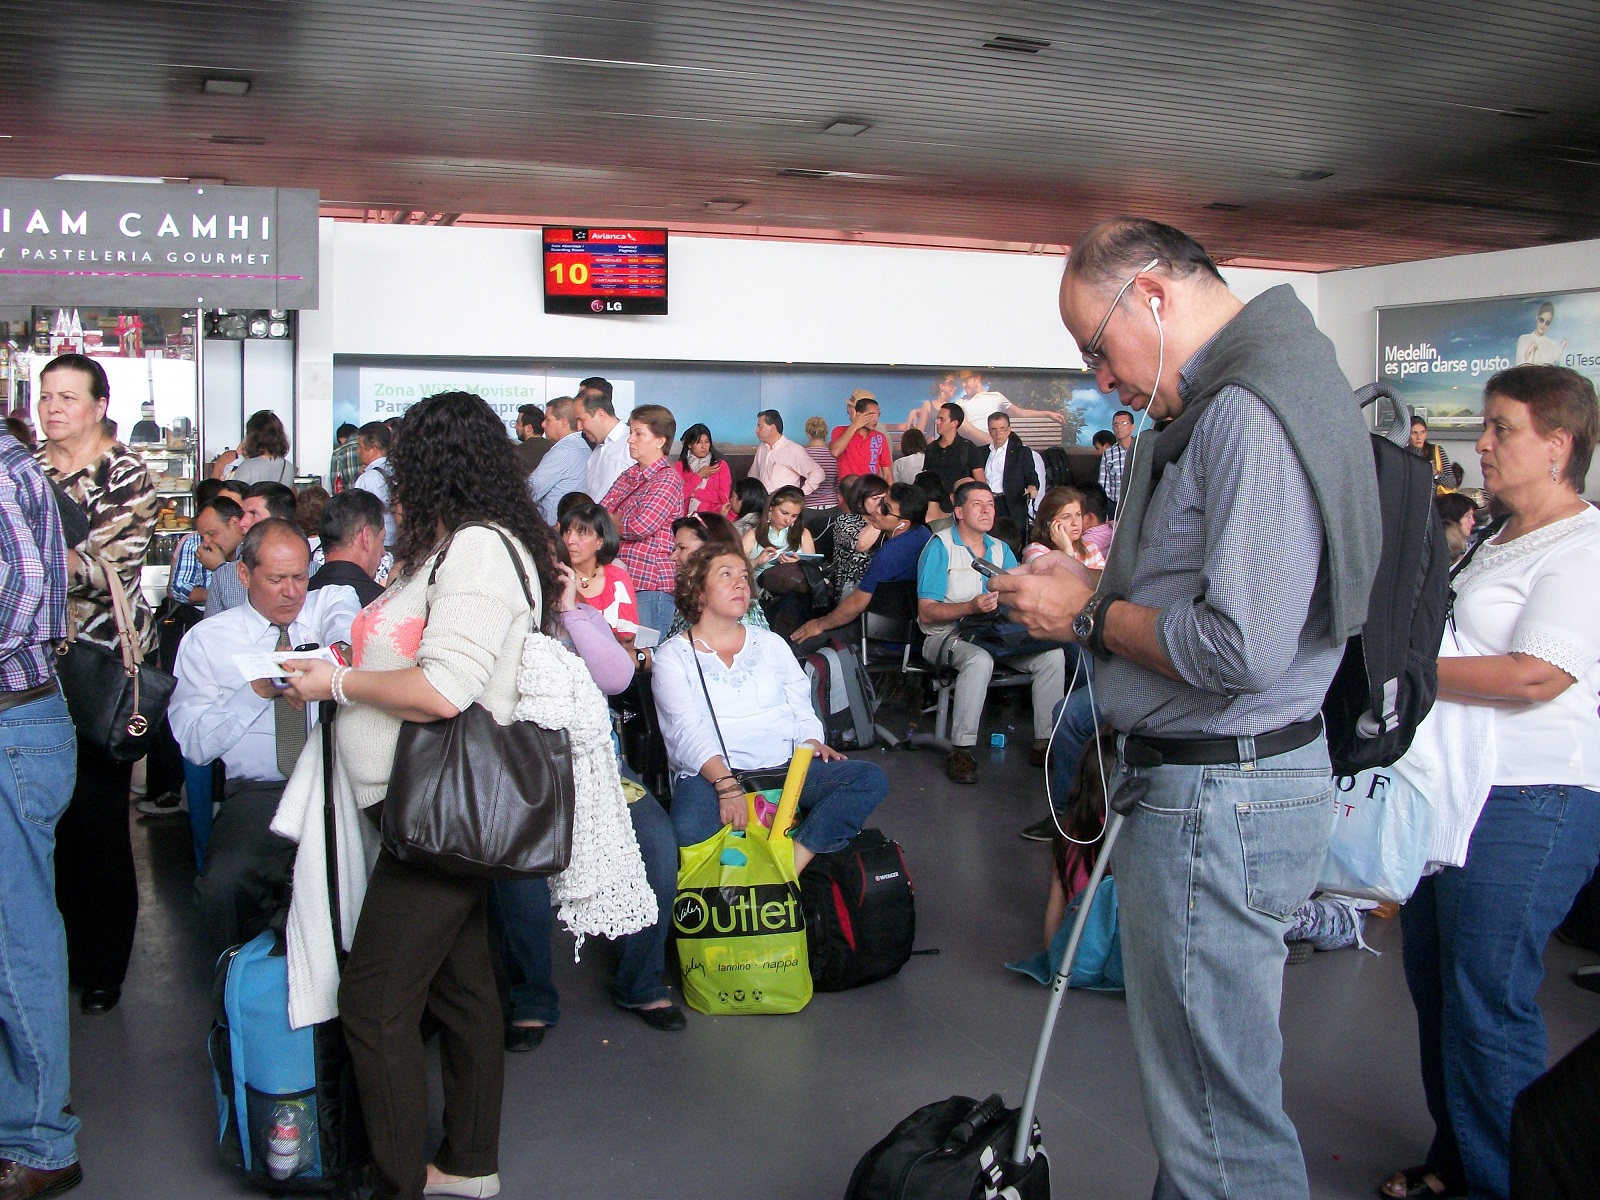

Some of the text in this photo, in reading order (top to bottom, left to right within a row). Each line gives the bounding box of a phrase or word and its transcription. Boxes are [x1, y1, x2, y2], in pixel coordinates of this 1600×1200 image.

[2, 208, 270, 240] IAM CAMHI
[591, 232, 627, 240] Avianca
[21, 249, 152, 262] PASTELERIA
[166, 251, 270, 265] GOURMET
[549, 262, 588, 285] 10
[606, 301, 622, 311] LG
[1384, 343, 1437, 362] Medellín
[1565, 353, 1575, 366] El
[1384, 362, 1398, 375] es
[1400, 360, 1429, 379] para
[1431, 355, 1467, 373] darse
[374, 383, 415, 397] Zona
[466, 383, 536, 397] Movistar
[673, 887, 798, 934] Outlet
[718, 963, 751, 972] tannino
[762, 958, 799, 973] nappa
